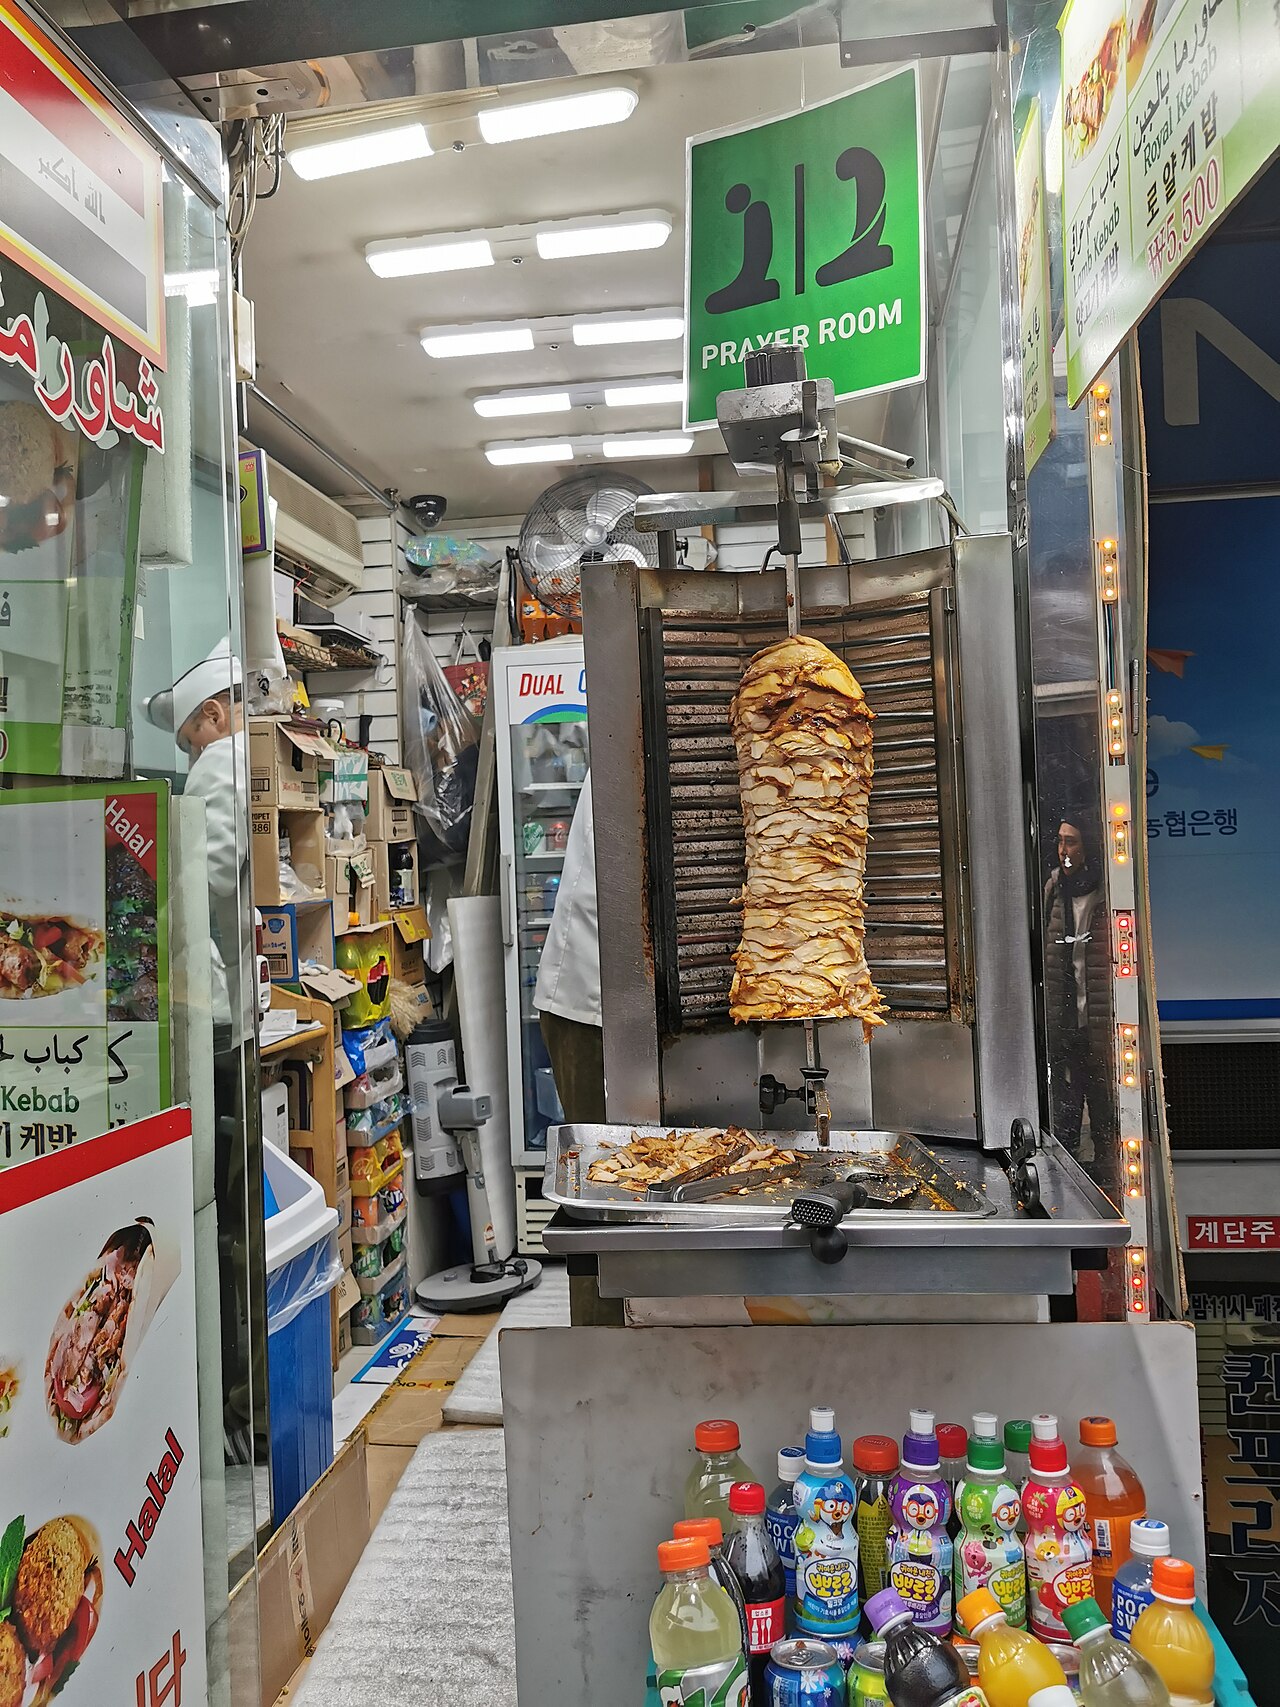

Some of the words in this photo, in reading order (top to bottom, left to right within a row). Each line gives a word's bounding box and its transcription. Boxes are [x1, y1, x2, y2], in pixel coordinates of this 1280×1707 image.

[1143, 106, 1173, 177] Royal
[1176, 42, 1218, 124] Kebab
[1100, 134, 1121, 205] كباب
[1073, 248, 1093, 298] Lamb
[1093, 200, 1120, 263] Kebab
[702, 324, 810, 370] PRAYER
[819, 298, 902, 345] ROOM
[0, 313, 165, 455] شاورم
[519, 673, 565, 697] DUAL
[105, 799, 154, 859] Halal
[24, 1033, 89, 1075] كباب
[1, 1085, 80, 1113] Kebab
[1195, 1220, 1280, 1245] 계단주
[114, 1427, 185, 1588] Halal
[766, 1519, 794, 1539] POC
[809, 1571, 853, 1598] 뽀로로
[892, 1572, 937, 1602] 뽀로로
